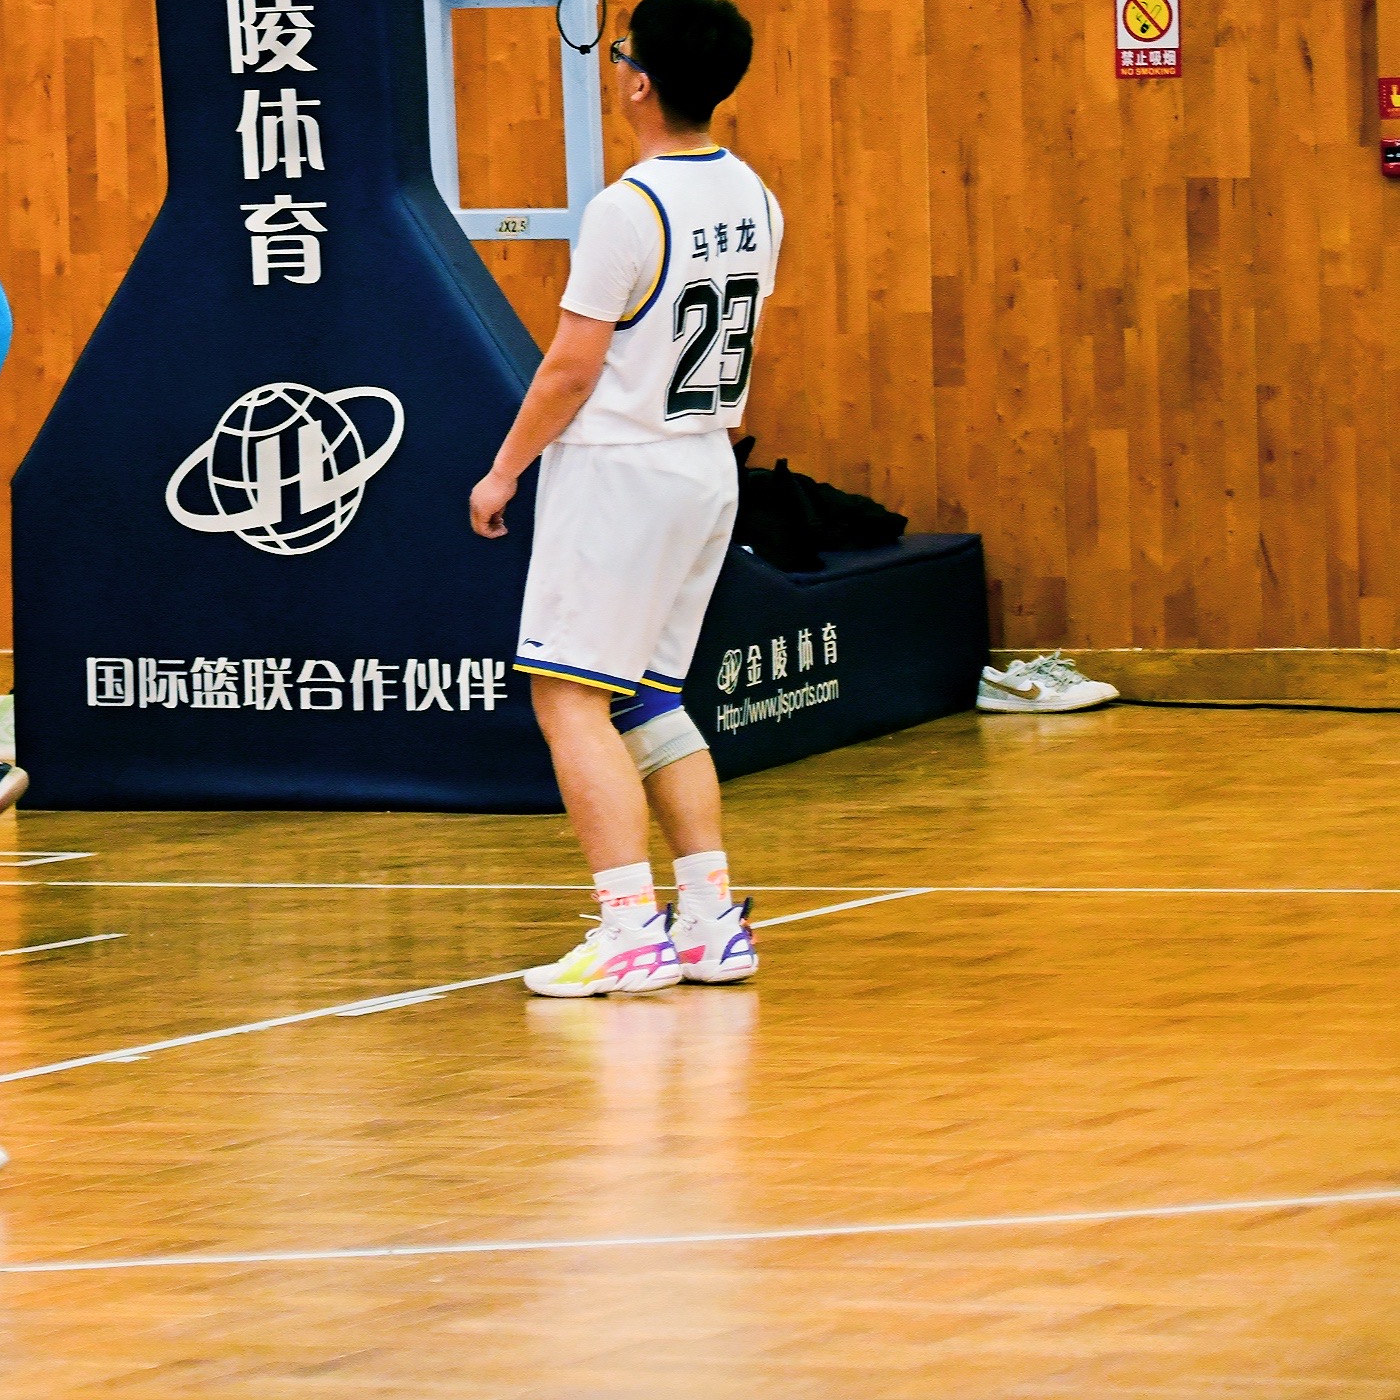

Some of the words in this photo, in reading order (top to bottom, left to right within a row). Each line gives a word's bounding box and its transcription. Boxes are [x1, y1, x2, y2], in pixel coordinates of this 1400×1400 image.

[1120, 50, 1177, 67] 禁止吸烟
[1120, 68, 1134, 76] NO
[1135, 67, 1176, 76] SMOKING
[664, 272, 760, 421] 23
[745, 622, 838, 687] 金陵体育
[85, 656, 508, 712] 国际篮联合作伙伴
